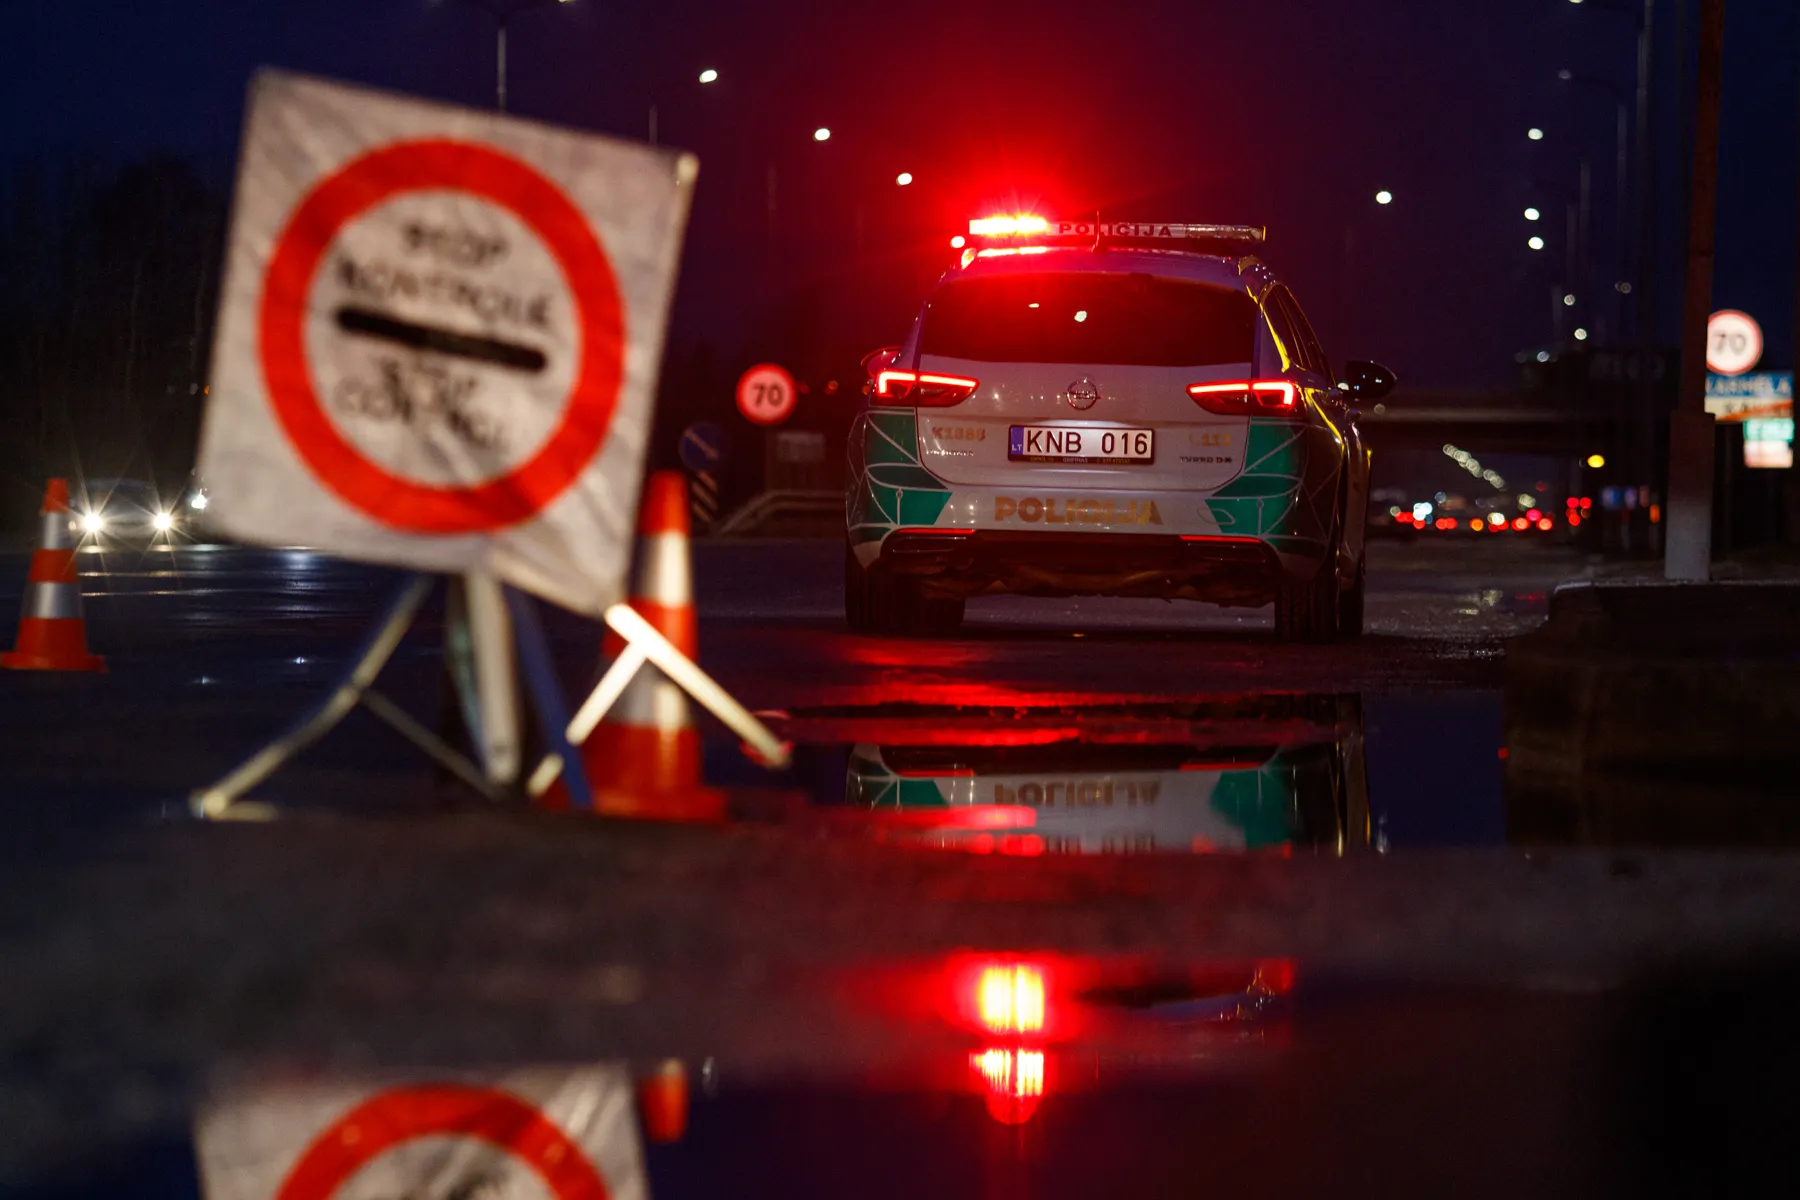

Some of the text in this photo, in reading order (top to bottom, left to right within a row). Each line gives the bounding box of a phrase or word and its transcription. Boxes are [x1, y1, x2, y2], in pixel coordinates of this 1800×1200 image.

[1058, 222, 1173, 238] POLICIJA
[1711, 332, 1747, 356] 70
[752, 382, 784, 407] 70
[1011, 430, 1148, 455] LT KNB 016
[994, 496, 1164, 526] POLICIJA
